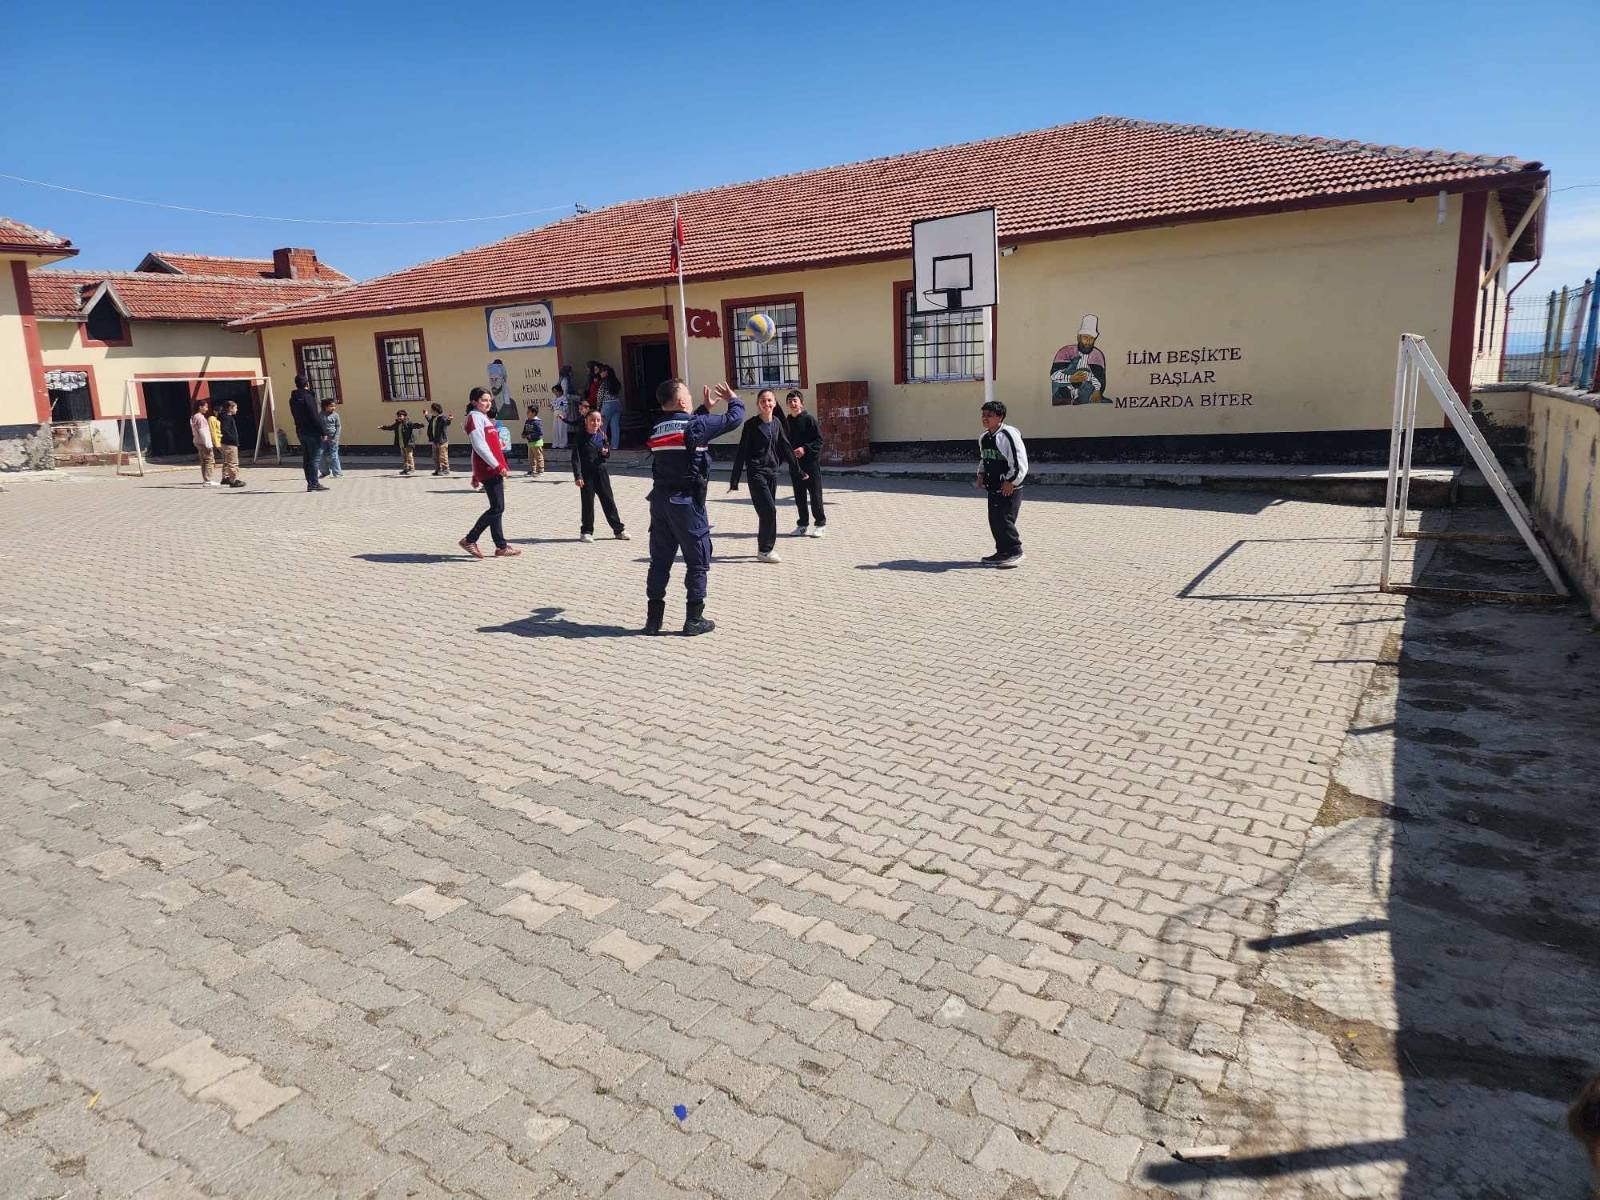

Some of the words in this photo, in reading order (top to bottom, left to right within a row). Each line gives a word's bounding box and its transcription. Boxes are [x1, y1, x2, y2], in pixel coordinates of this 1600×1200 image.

[511, 317, 547, 330] YAVUHASAN
[512, 330, 540, 342] İLKOKULU
[1127, 349, 1162, 365] İLİM
[1166, 346, 1242, 365] BEŞİKTE
[1150, 370, 1217, 387] BAŞLAR
[1114, 394, 1194, 409] MEZARDA
[1200, 391, 1255, 407] BİTER
